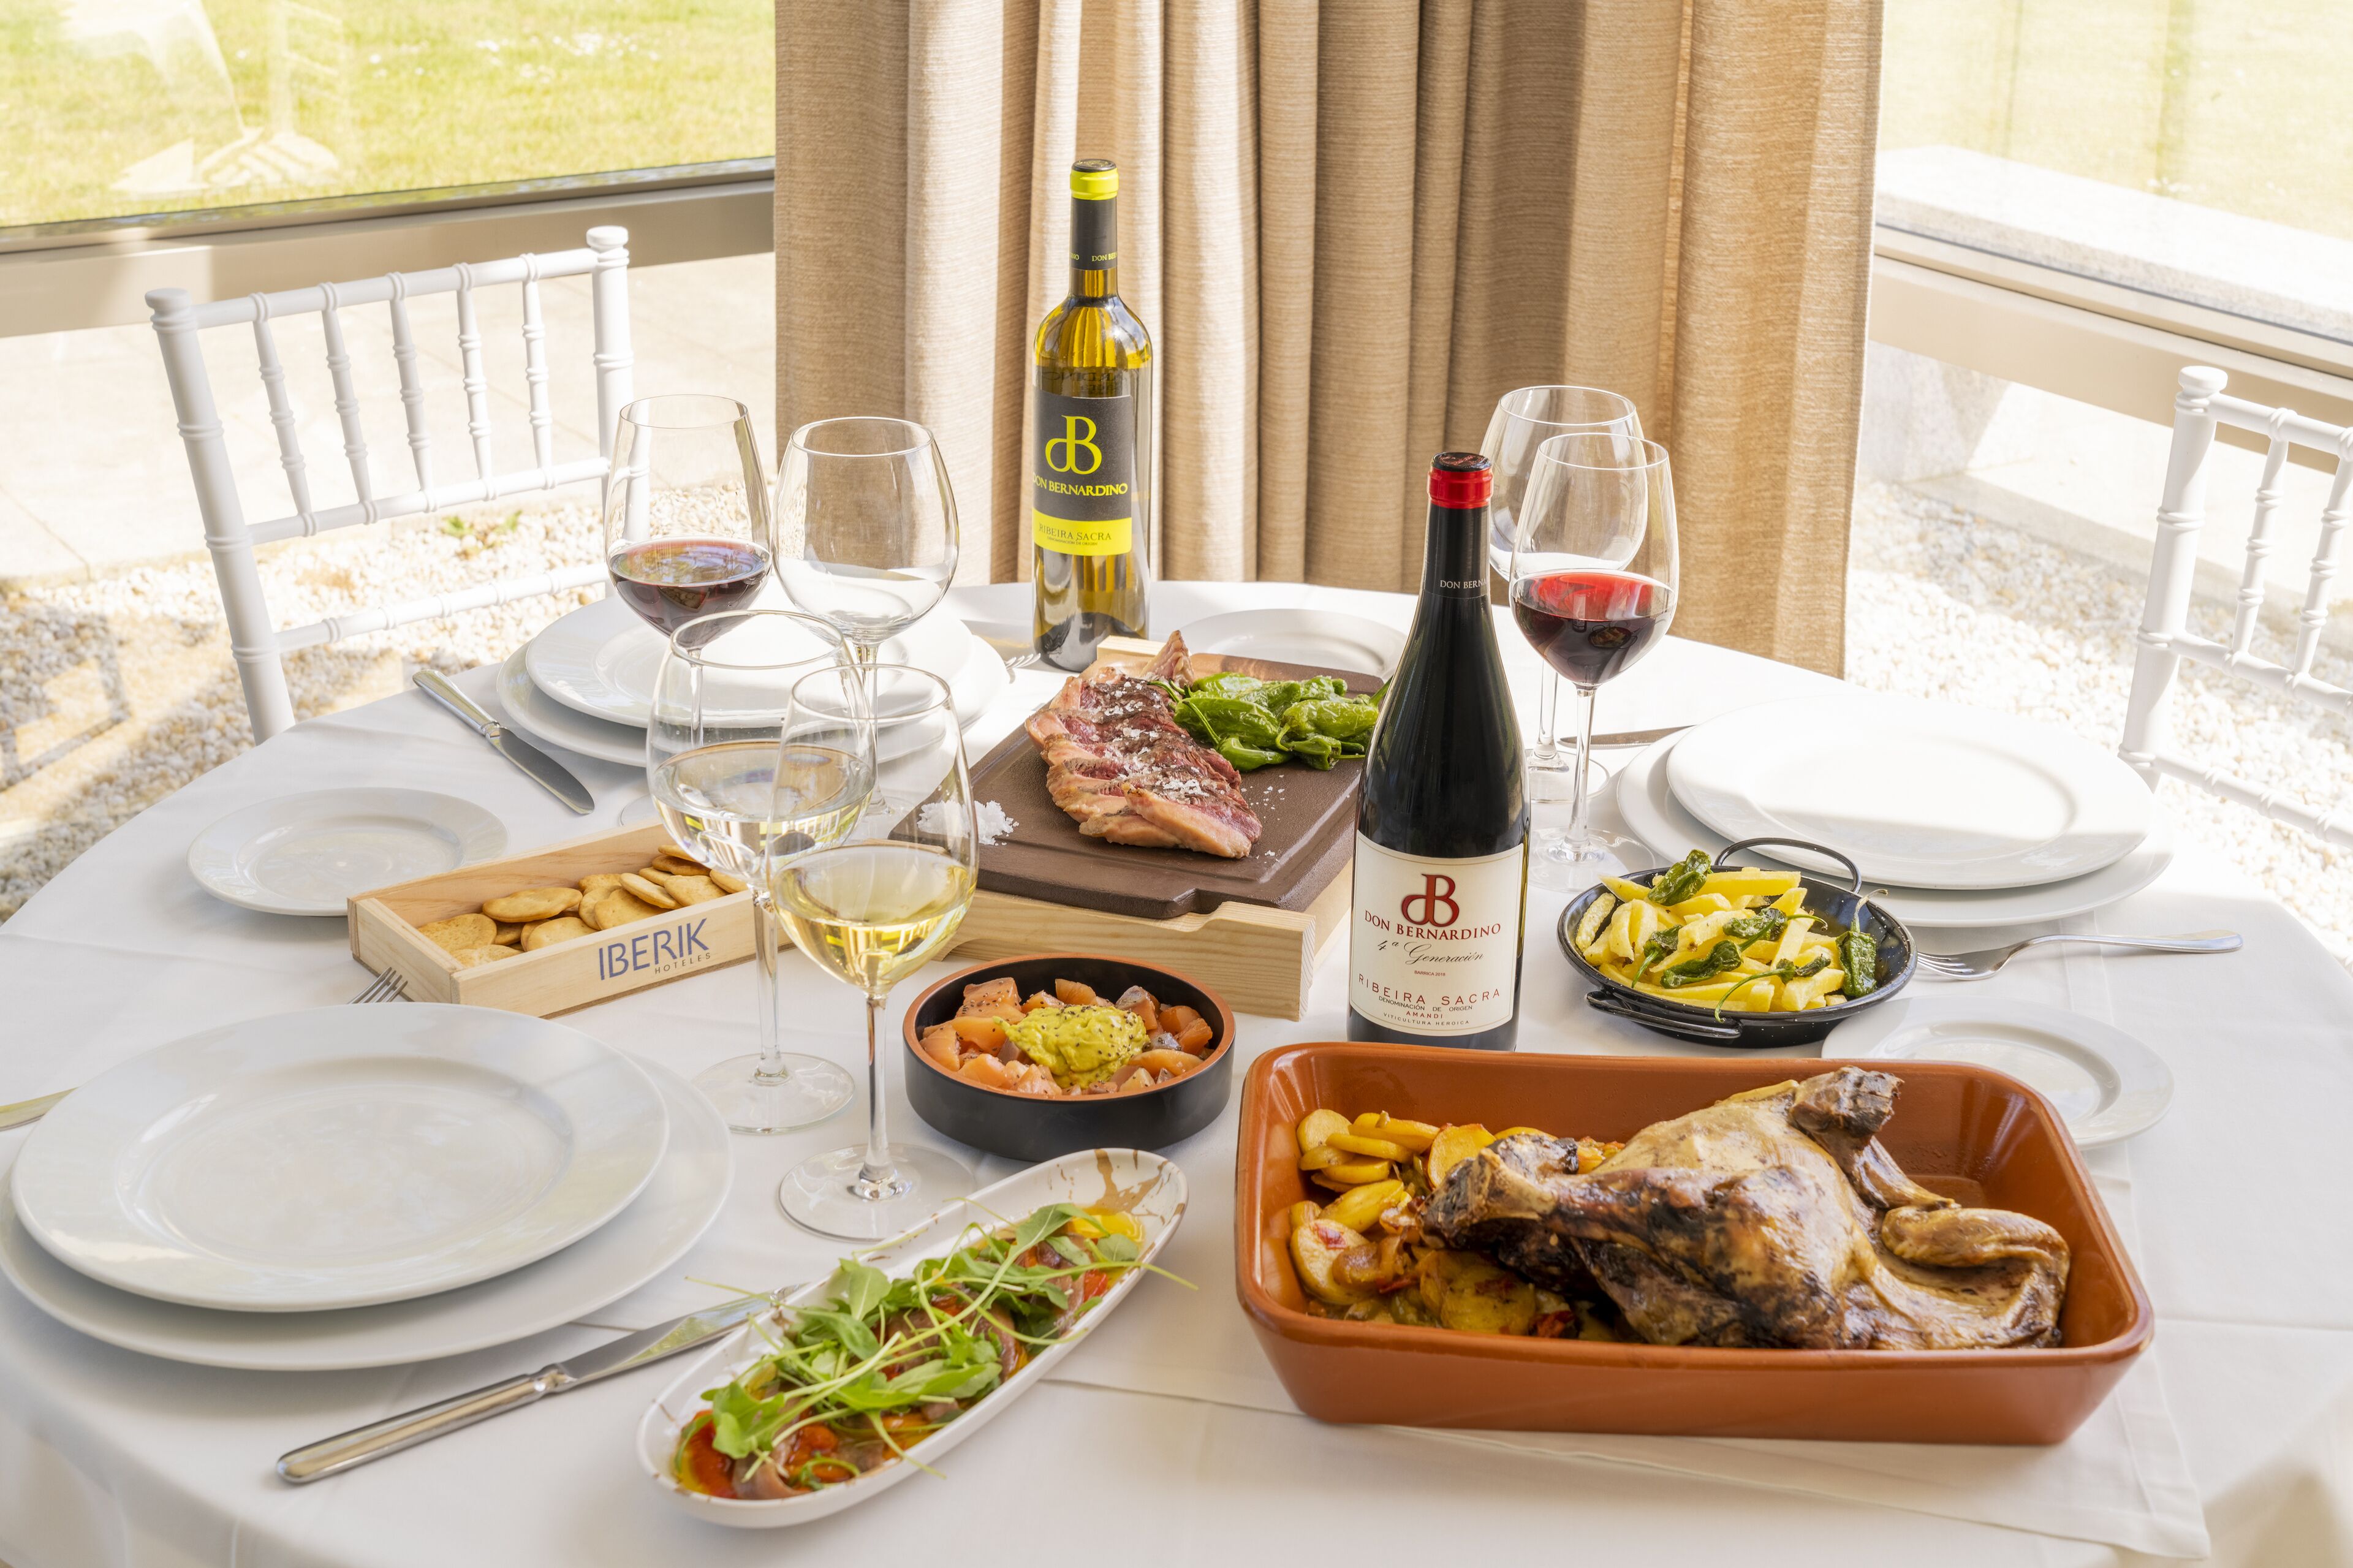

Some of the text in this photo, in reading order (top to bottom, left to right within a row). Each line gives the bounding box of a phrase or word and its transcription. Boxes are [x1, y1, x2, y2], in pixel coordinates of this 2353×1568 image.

[1048, 482, 1128, 496] BERNARDINO
[1039, 523, 1112, 540] RIBEIRA SACRA
[1440, 580, 1461, 589] DON
[1365, 910, 1501, 941] DON BERNARDINO
[599, 918, 710, 981] IBERIK
[1403, 941, 1483, 966] Generación
[655, 952, 711, 974] HOTELES
[1358, 973, 1500, 1006] RIBEIRA SACRA
[1379, 996, 1425, 1011] DENOMINACIÓN
[1383, 1012, 1431, 1026] VITICULTURA
